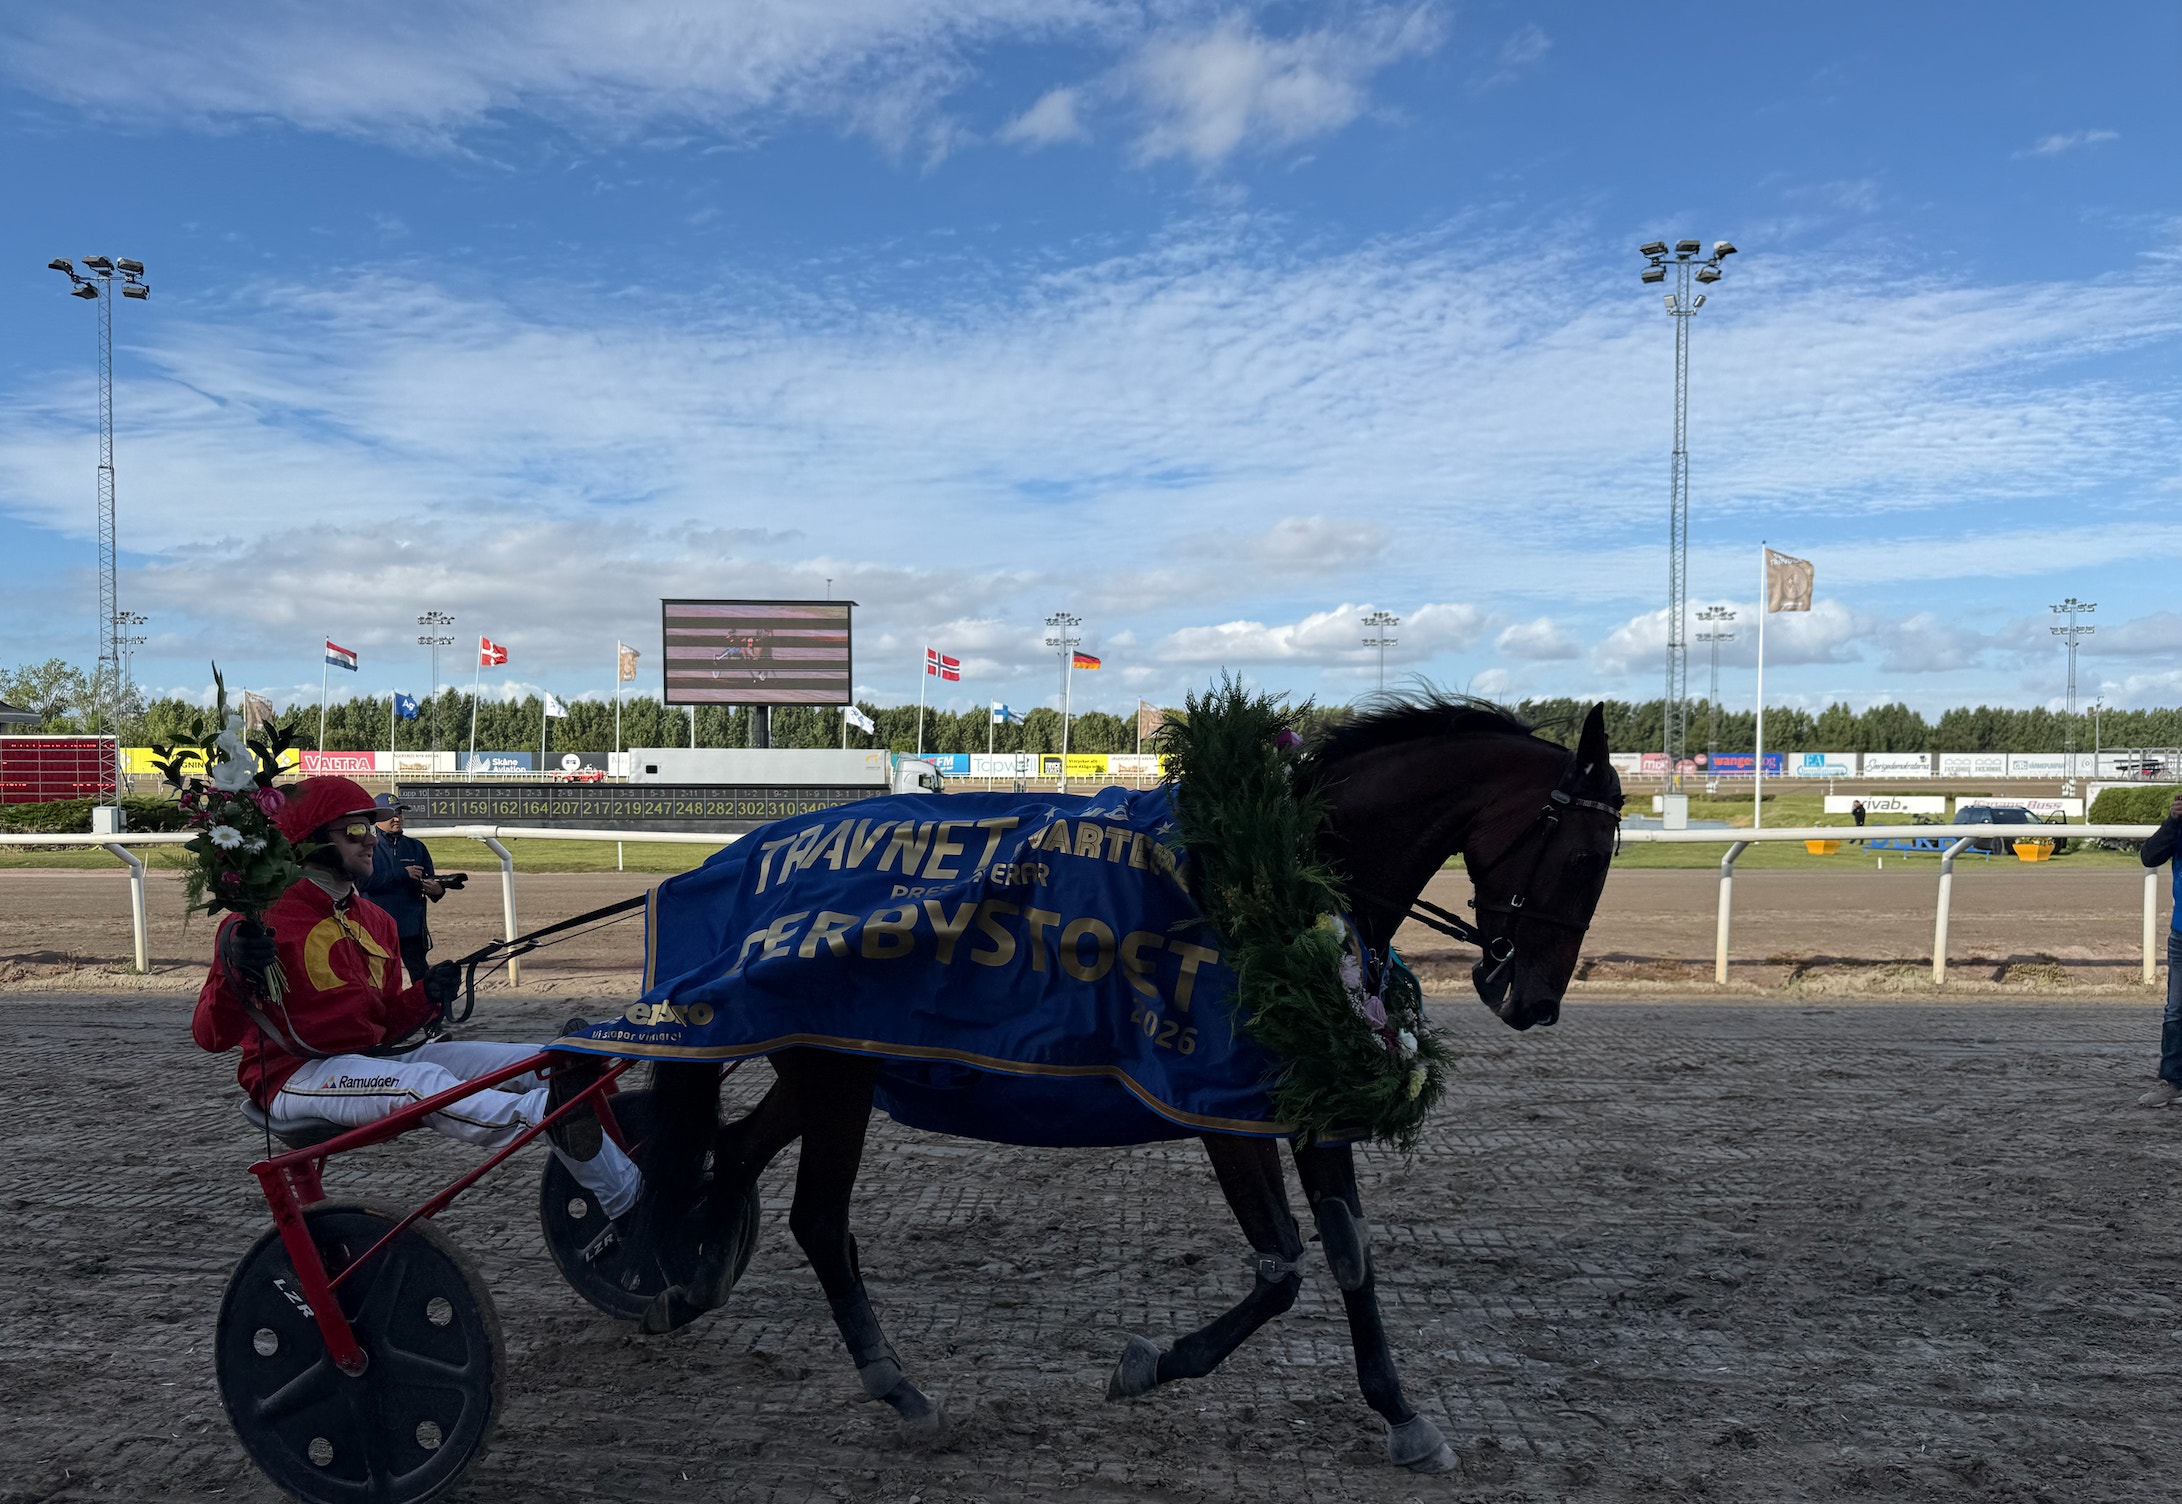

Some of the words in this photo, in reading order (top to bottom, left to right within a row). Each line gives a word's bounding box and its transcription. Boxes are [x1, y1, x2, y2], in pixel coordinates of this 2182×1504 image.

[304, 755, 371, 771] VALTRA
[493, 757, 518, 766] Skåne
[936, 756, 954, 766] FM
[973, 758, 1037, 774] Tapwll
[1713, 756, 1776, 768] wangesog
[1804, 755, 1824, 767] EA
[1865, 759, 1930, 772] Sverigedemokraterna
[493, 765, 527, 773] Aviation
[418, 789, 429, 797] 10
[431, 801, 456, 815] 121
[461, 801, 488, 815] 159
[491, 801, 518, 815] 162
[522, 801, 549, 815] 164
[552, 801, 580, 815] 207
[583, 801, 611, 815] 217
[614, 801, 641, 815] 219
[645, 801, 673, 815] 247
[676, 801, 703, 815] 248
[706, 801, 734, 815] 282
[737, 801, 765, 815] 302
[768, 801, 796, 815] 310
[799, 802, 827, 815] 340
[755, 816, 1019, 895] TRAVNET
[1130, 996, 1199, 1055] 2026
[585, 1233, 614, 1262] LZR
[273, 1279, 315, 1319] LZR
